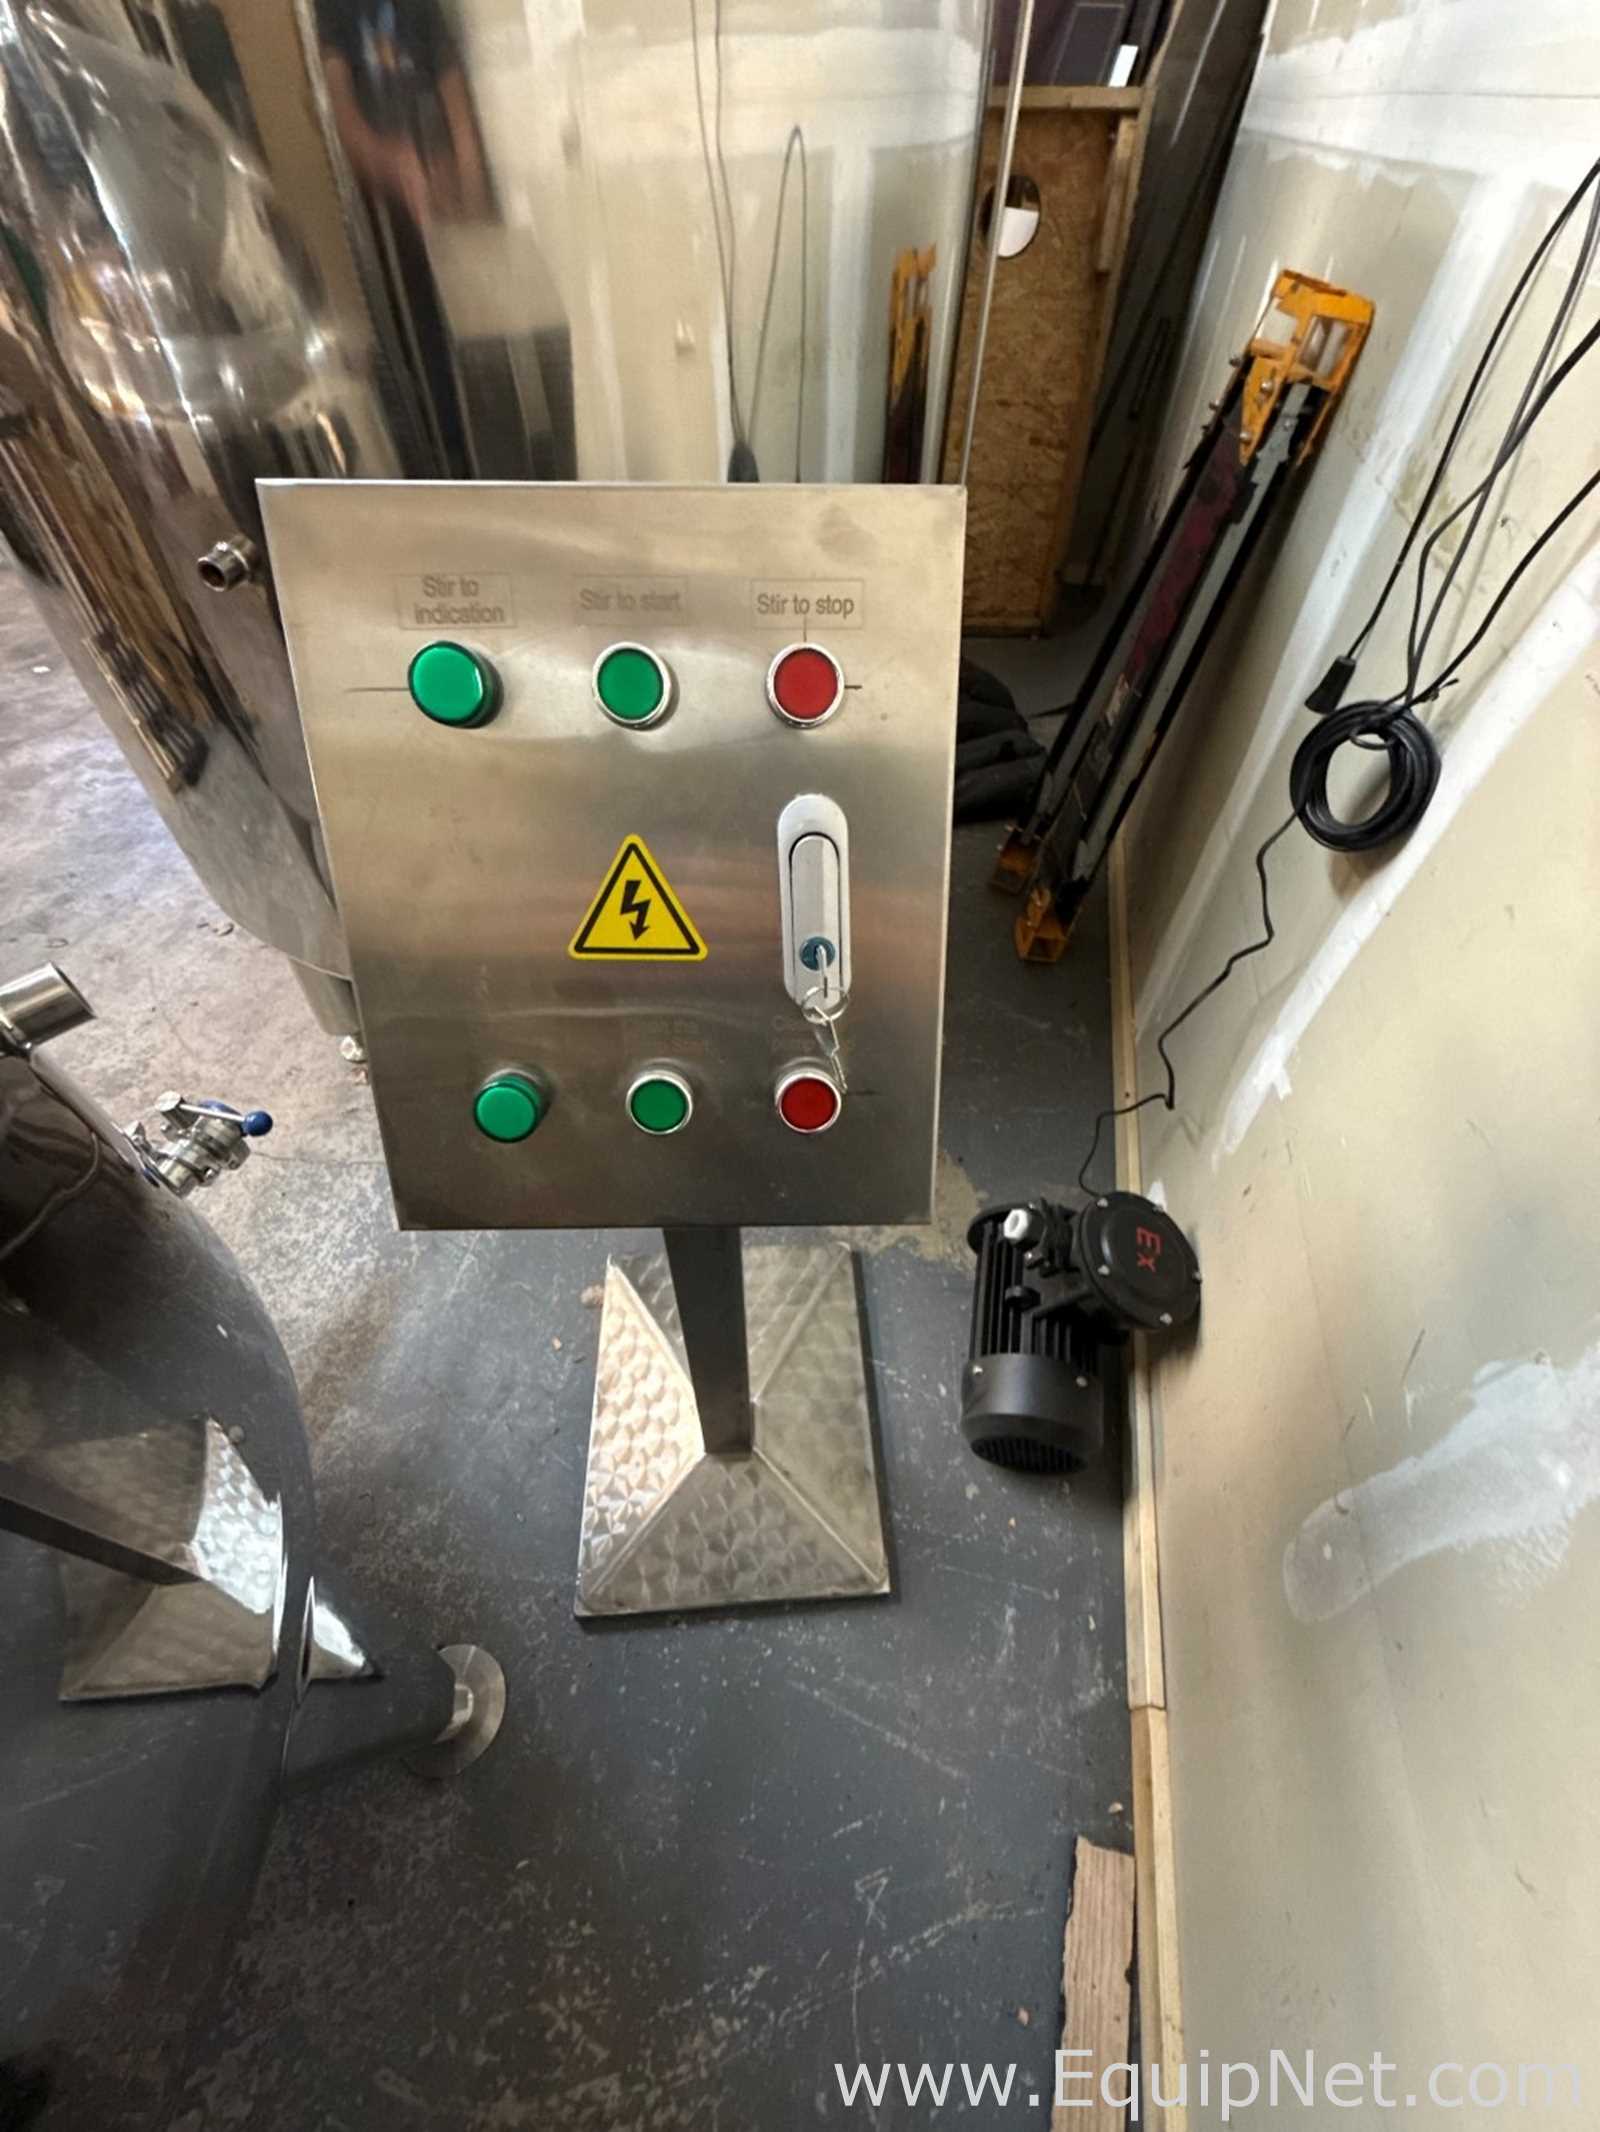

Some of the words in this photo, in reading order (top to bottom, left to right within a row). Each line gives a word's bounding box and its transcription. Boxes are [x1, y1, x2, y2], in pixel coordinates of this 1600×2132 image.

[422, 575, 456, 598] Stir
[460, 576, 480, 597] to
[757, 593, 788, 615] Stir
[792, 594, 811, 615] to
[815, 594, 855, 620] stop
[1136, 1225, 1163, 1272] Ex
